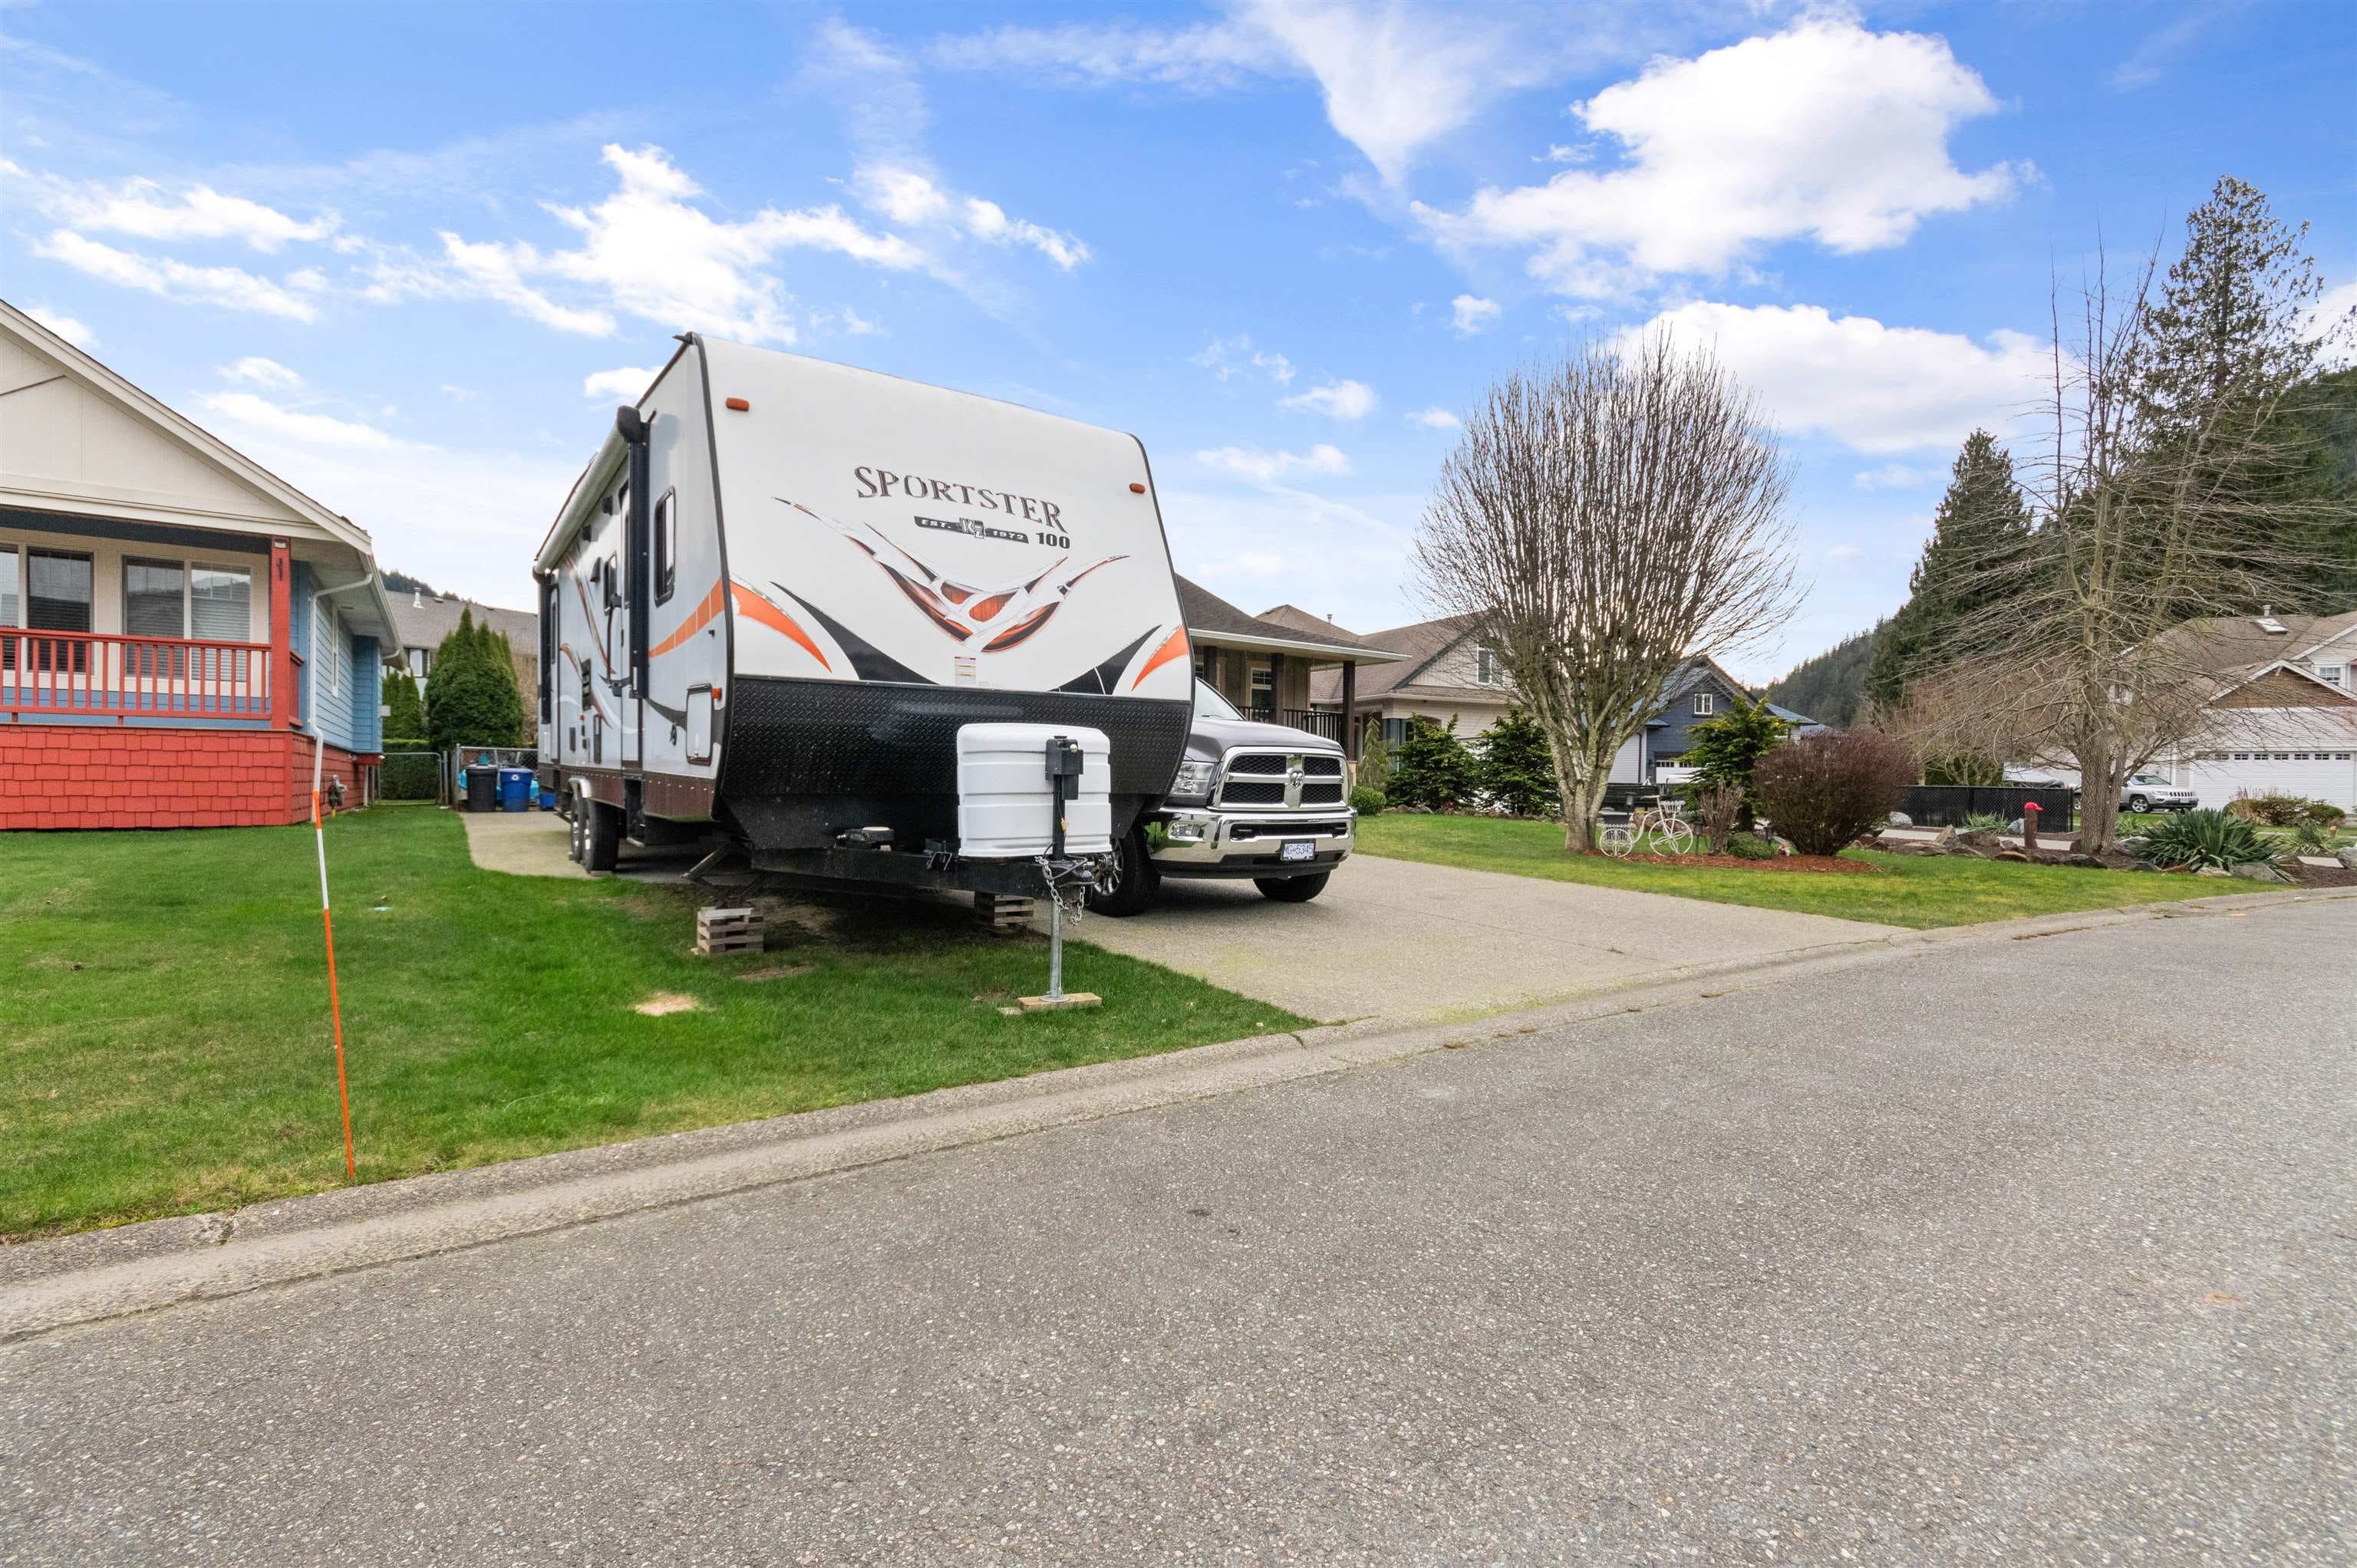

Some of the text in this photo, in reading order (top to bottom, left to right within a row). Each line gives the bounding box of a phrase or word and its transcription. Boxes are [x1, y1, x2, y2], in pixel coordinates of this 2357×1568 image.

[854, 465, 1068, 533] SPORTSTER
[921, 519, 952, 529] EST.
[993, 529, 1024, 540] 1972
[1035, 532, 1070, 549] 100
